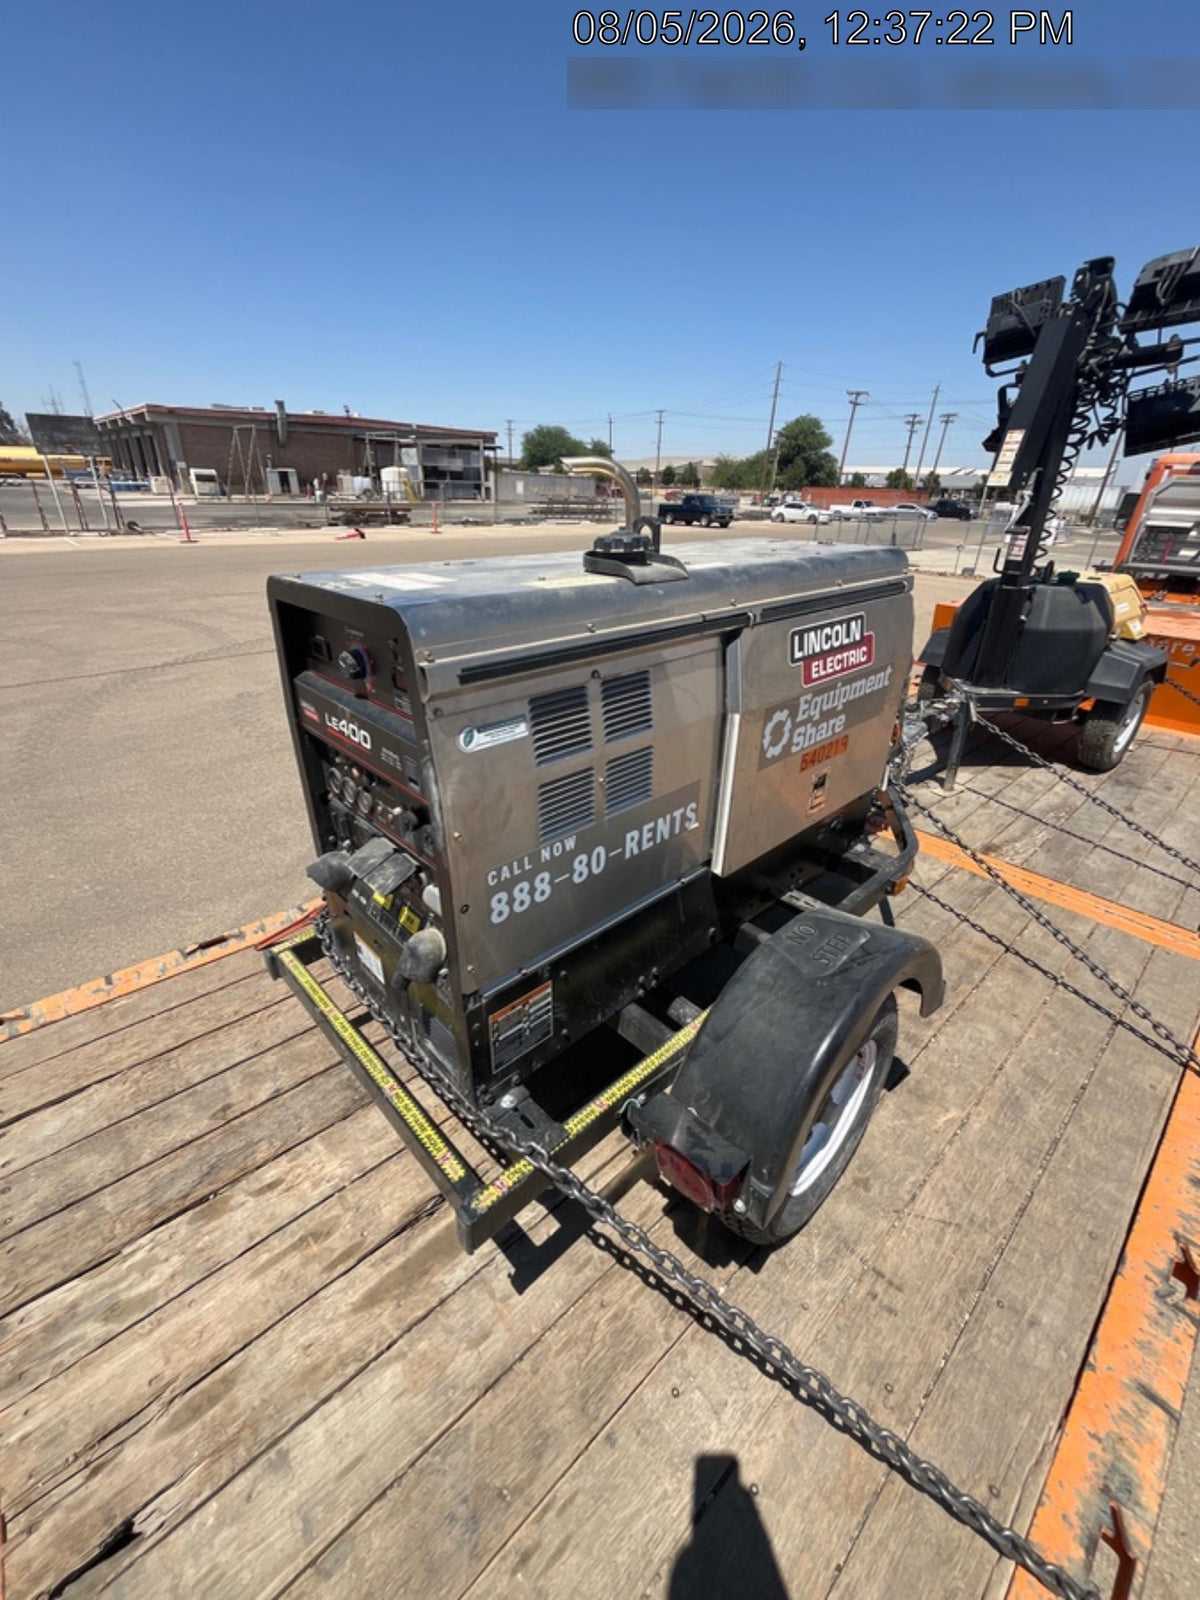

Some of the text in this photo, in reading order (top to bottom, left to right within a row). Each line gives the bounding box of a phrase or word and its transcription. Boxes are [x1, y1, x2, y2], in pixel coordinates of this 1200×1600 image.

[794, 619, 862, 659] LINCOLN
[811, 646, 868, 679] ELECTRIC
[796, 665, 893, 722] Equipment
[324, 712, 372, 750] LE400
[790, 714, 846, 753] Share
[487, 835, 577, 887] CALL NOW
[489, 801, 700, 925] 888-80-RENTS
[784, 923, 817, 945] NO
[811, 932, 851, 967] STEP
